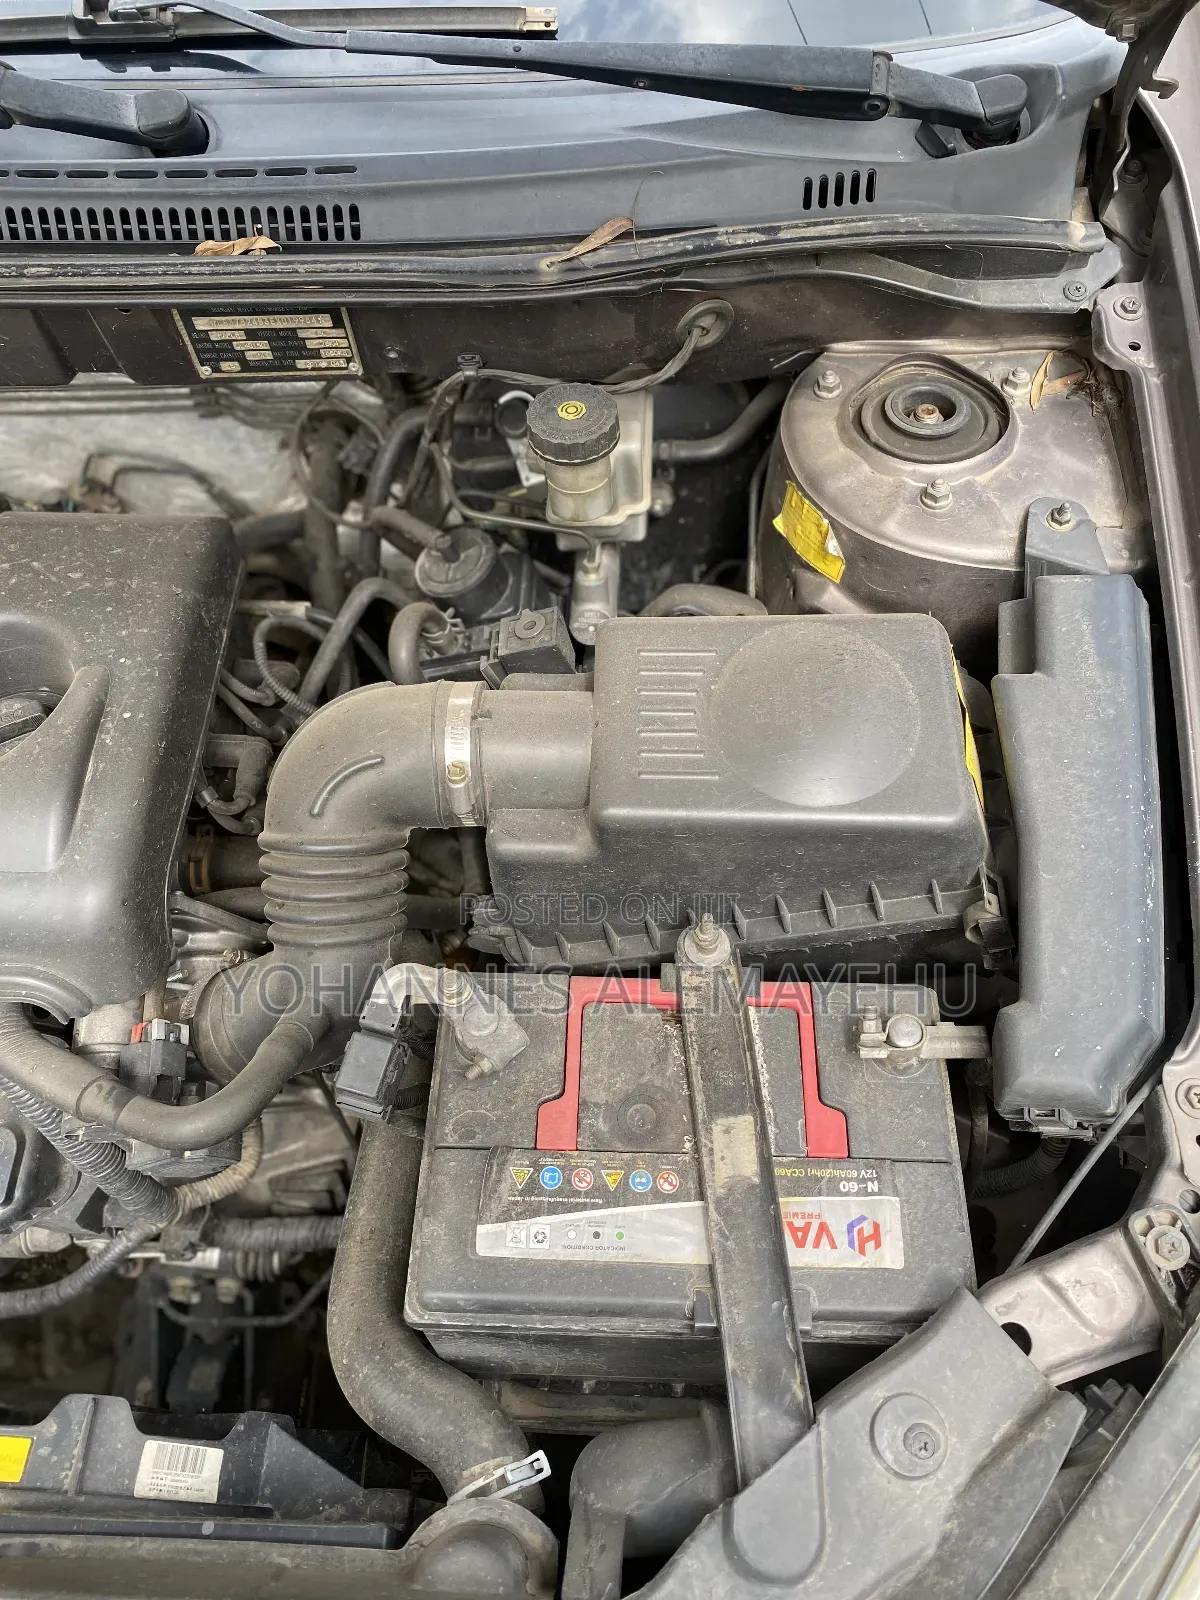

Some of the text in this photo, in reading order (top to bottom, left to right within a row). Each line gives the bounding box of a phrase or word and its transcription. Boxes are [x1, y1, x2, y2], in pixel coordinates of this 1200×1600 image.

[860, 1168, 878, 1178] 12V
[839, 1180, 879, 1192] N-60
[782, 1211, 821, 1220] PREMIE
[784, 1220, 839, 1250] VA
